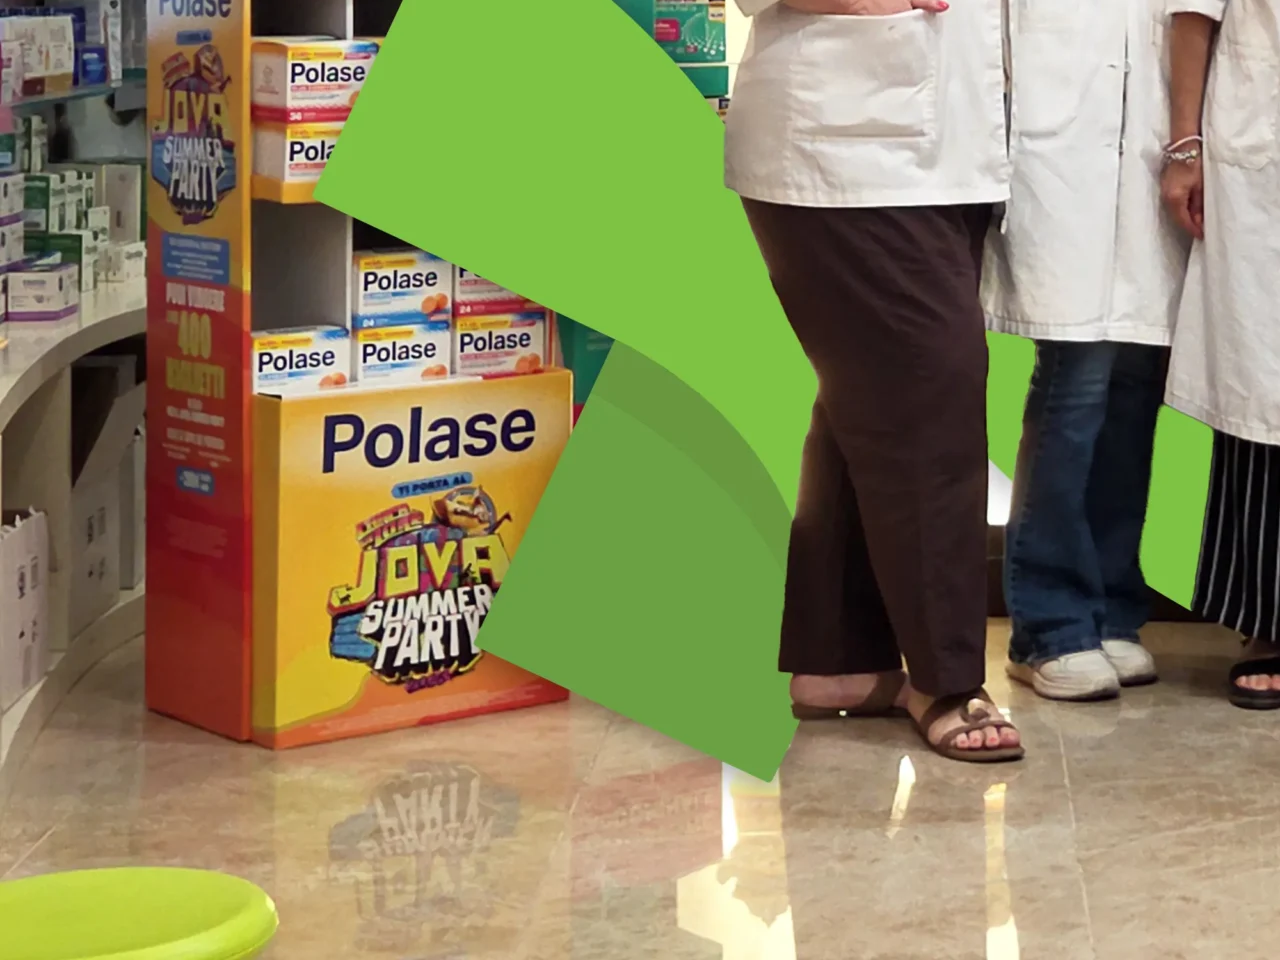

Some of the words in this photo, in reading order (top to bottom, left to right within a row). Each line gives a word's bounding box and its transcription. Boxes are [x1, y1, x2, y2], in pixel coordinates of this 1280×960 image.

[290, 62, 365, 83] Polase
[162, 136, 226, 169] SUMMER
[289, 140, 336, 162] Pola
[169, 159, 225, 203] PARTY
[363, 269, 438, 291] Polase
[362, 341, 436, 363] Polase
[459, 331, 531, 353] Polase
[257, 348, 336, 373] Polase
[322, 406, 536, 473] Polase
[412, 478, 449, 492] PORTA
[329, 534, 510, 612] JOVA
[360, 583, 494, 635] SUMMER
